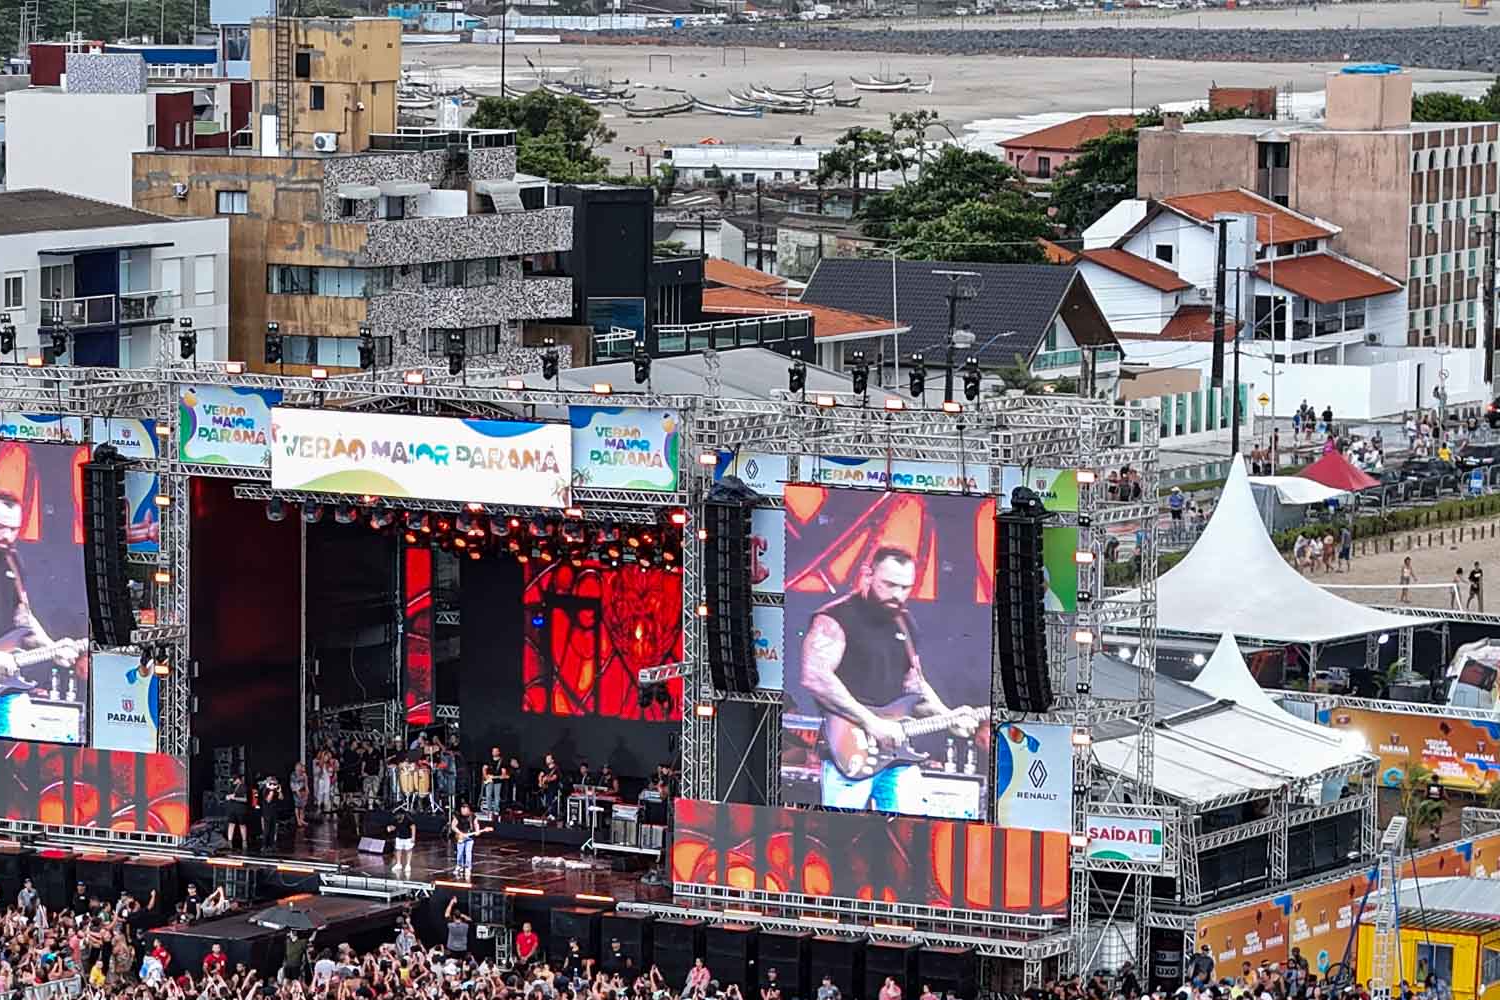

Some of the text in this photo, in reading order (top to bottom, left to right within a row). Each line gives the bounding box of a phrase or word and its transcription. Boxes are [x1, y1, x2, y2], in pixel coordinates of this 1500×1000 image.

[212, 416, 254, 429] MAIOR
[199, 427, 266, 445] PARANÁ
[605, 439, 651, 451] MAIOR
[282, 432, 561, 473] VERÃO MAIOR PARANÁ
[590, 449, 662, 468] PARANÁ
[107, 712, 147, 723] PARANÁ
[1017, 791, 1058, 800] RENAULT
[1089, 825, 1137, 841] SAÍDA
